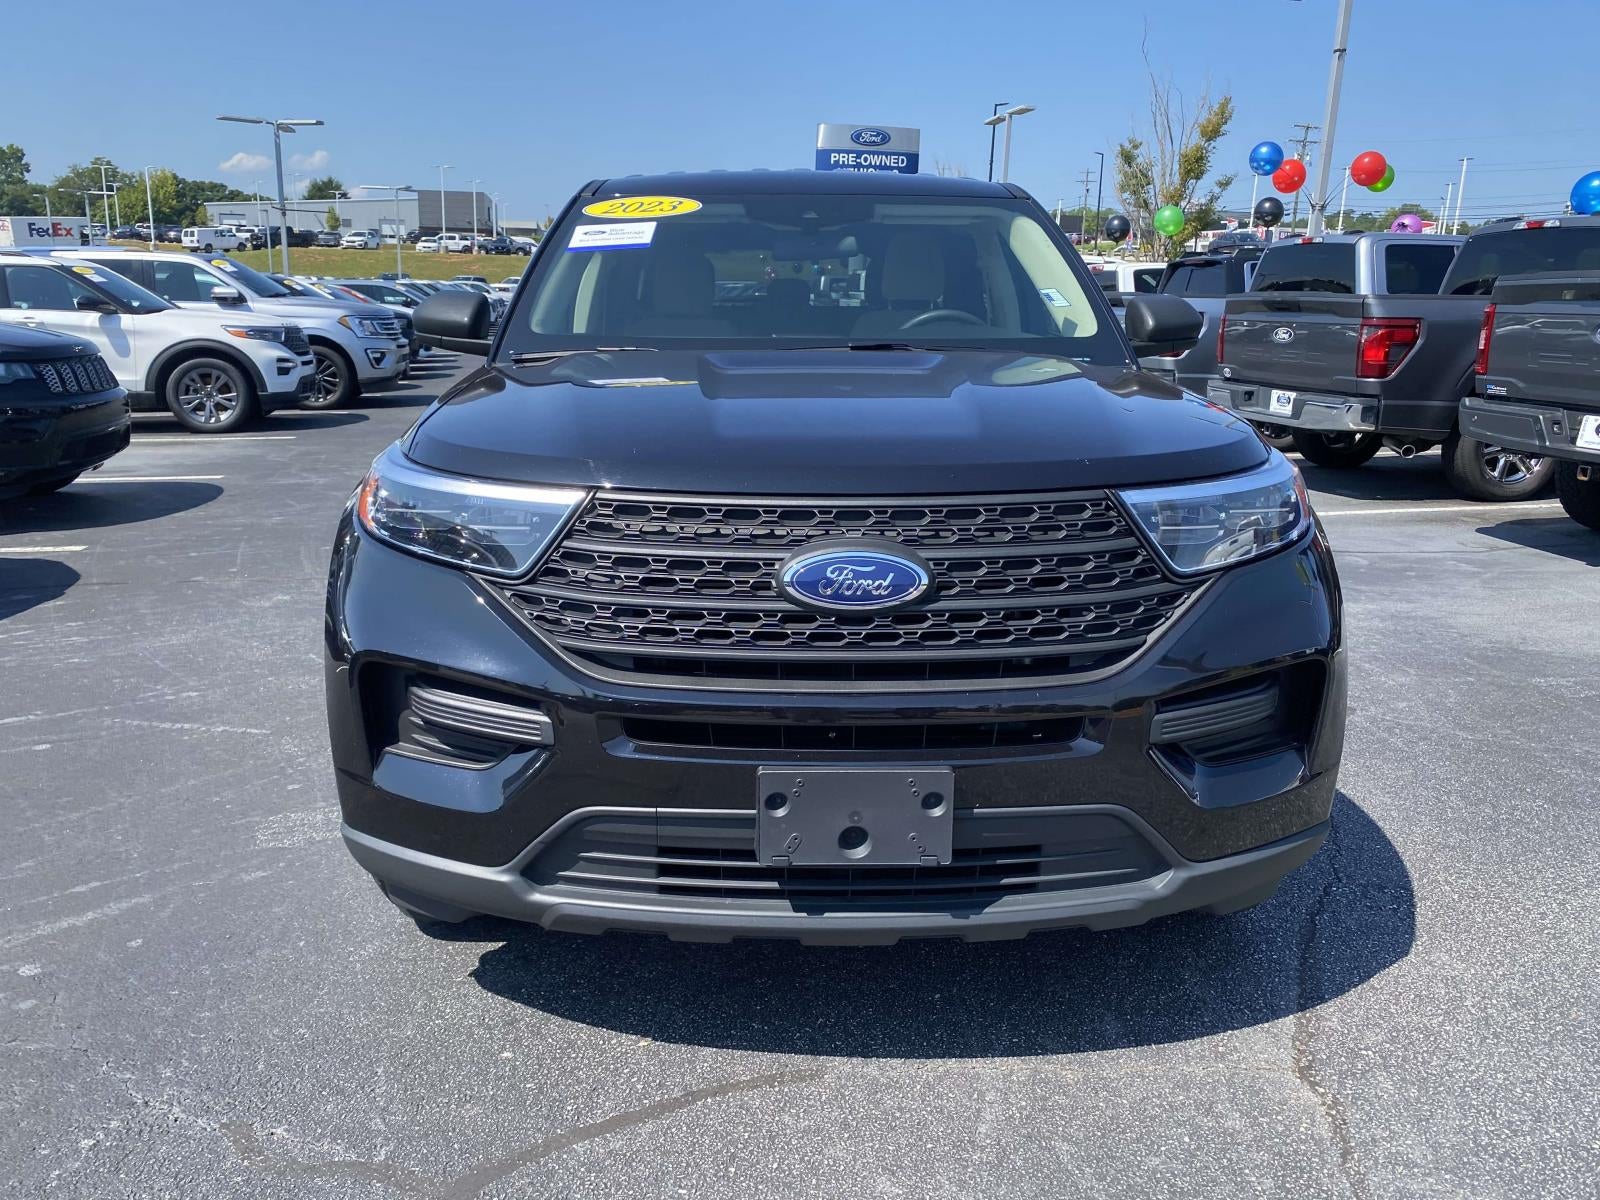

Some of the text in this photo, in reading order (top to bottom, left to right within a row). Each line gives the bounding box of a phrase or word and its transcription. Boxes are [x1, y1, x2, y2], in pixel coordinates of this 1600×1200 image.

[859, 131, 883, 143] Ford
[830, 153, 907, 167] PRE-OWNED
[601, 200, 683, 215] 2023
[818, 564, 895, 596] Ford
